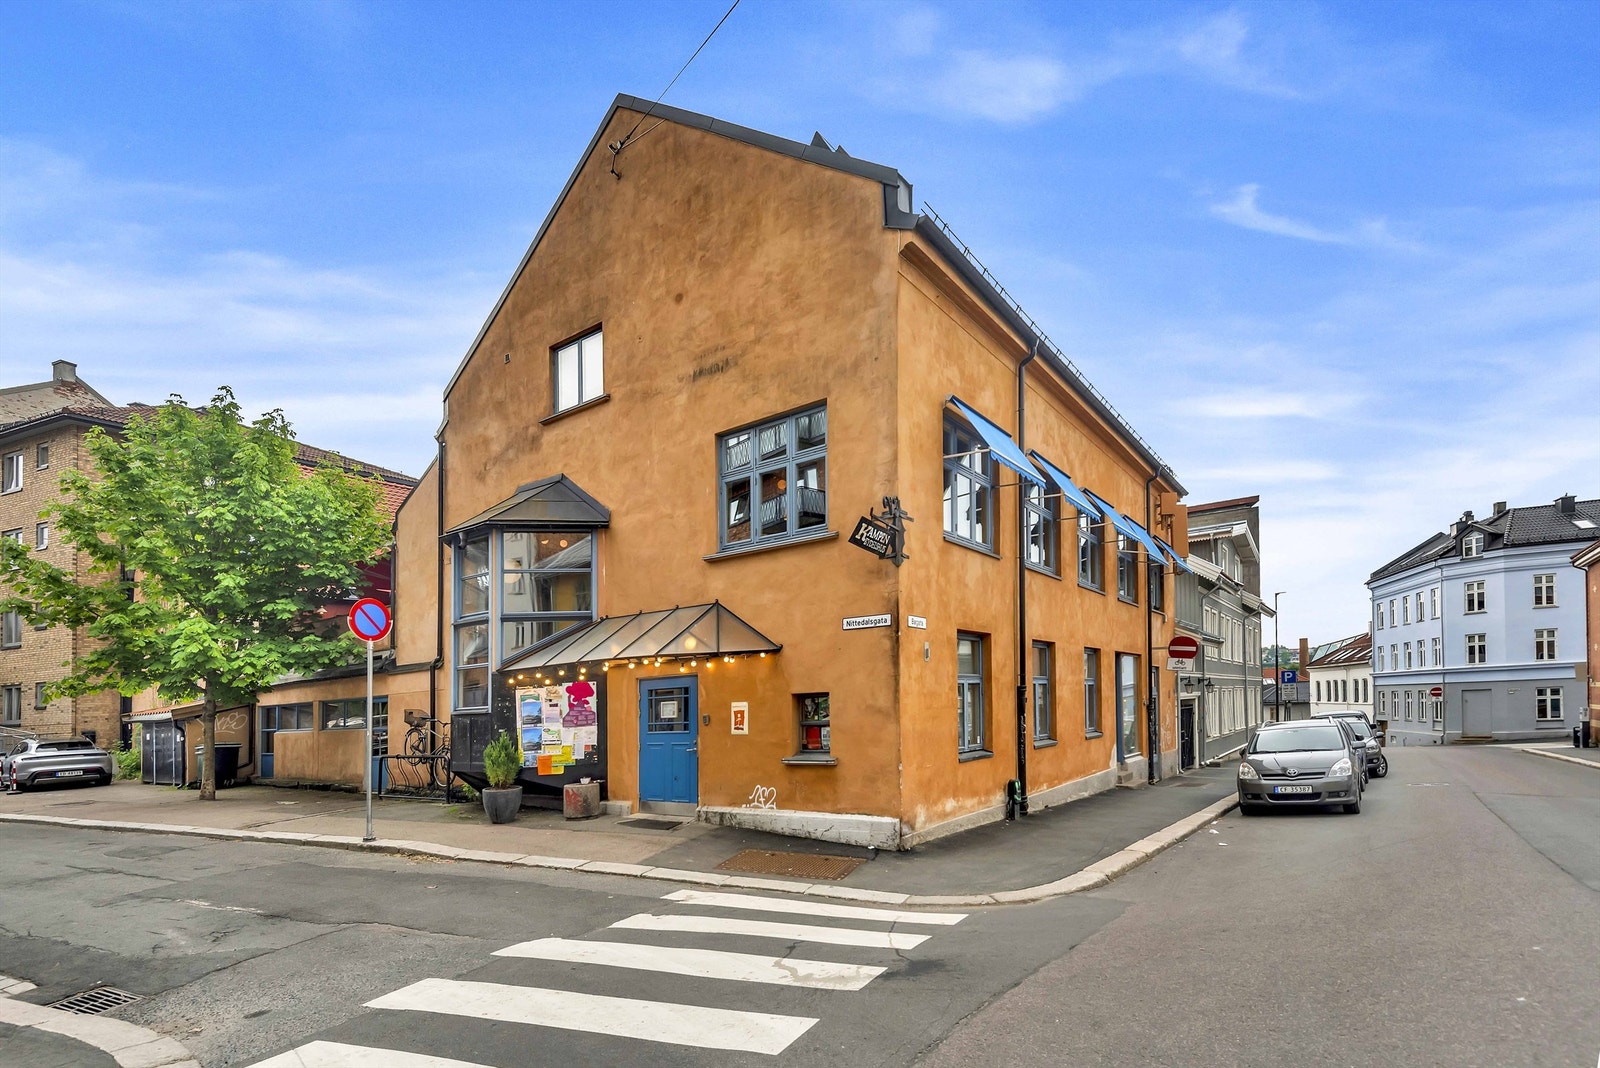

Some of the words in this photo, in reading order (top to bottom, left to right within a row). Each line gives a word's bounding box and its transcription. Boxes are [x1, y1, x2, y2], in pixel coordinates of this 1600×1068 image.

[855, 523, 890, 545] KAMPEN
[846, 617, 887, 627] Nittedalsgata
[1284, 672, 1293, 682] P
